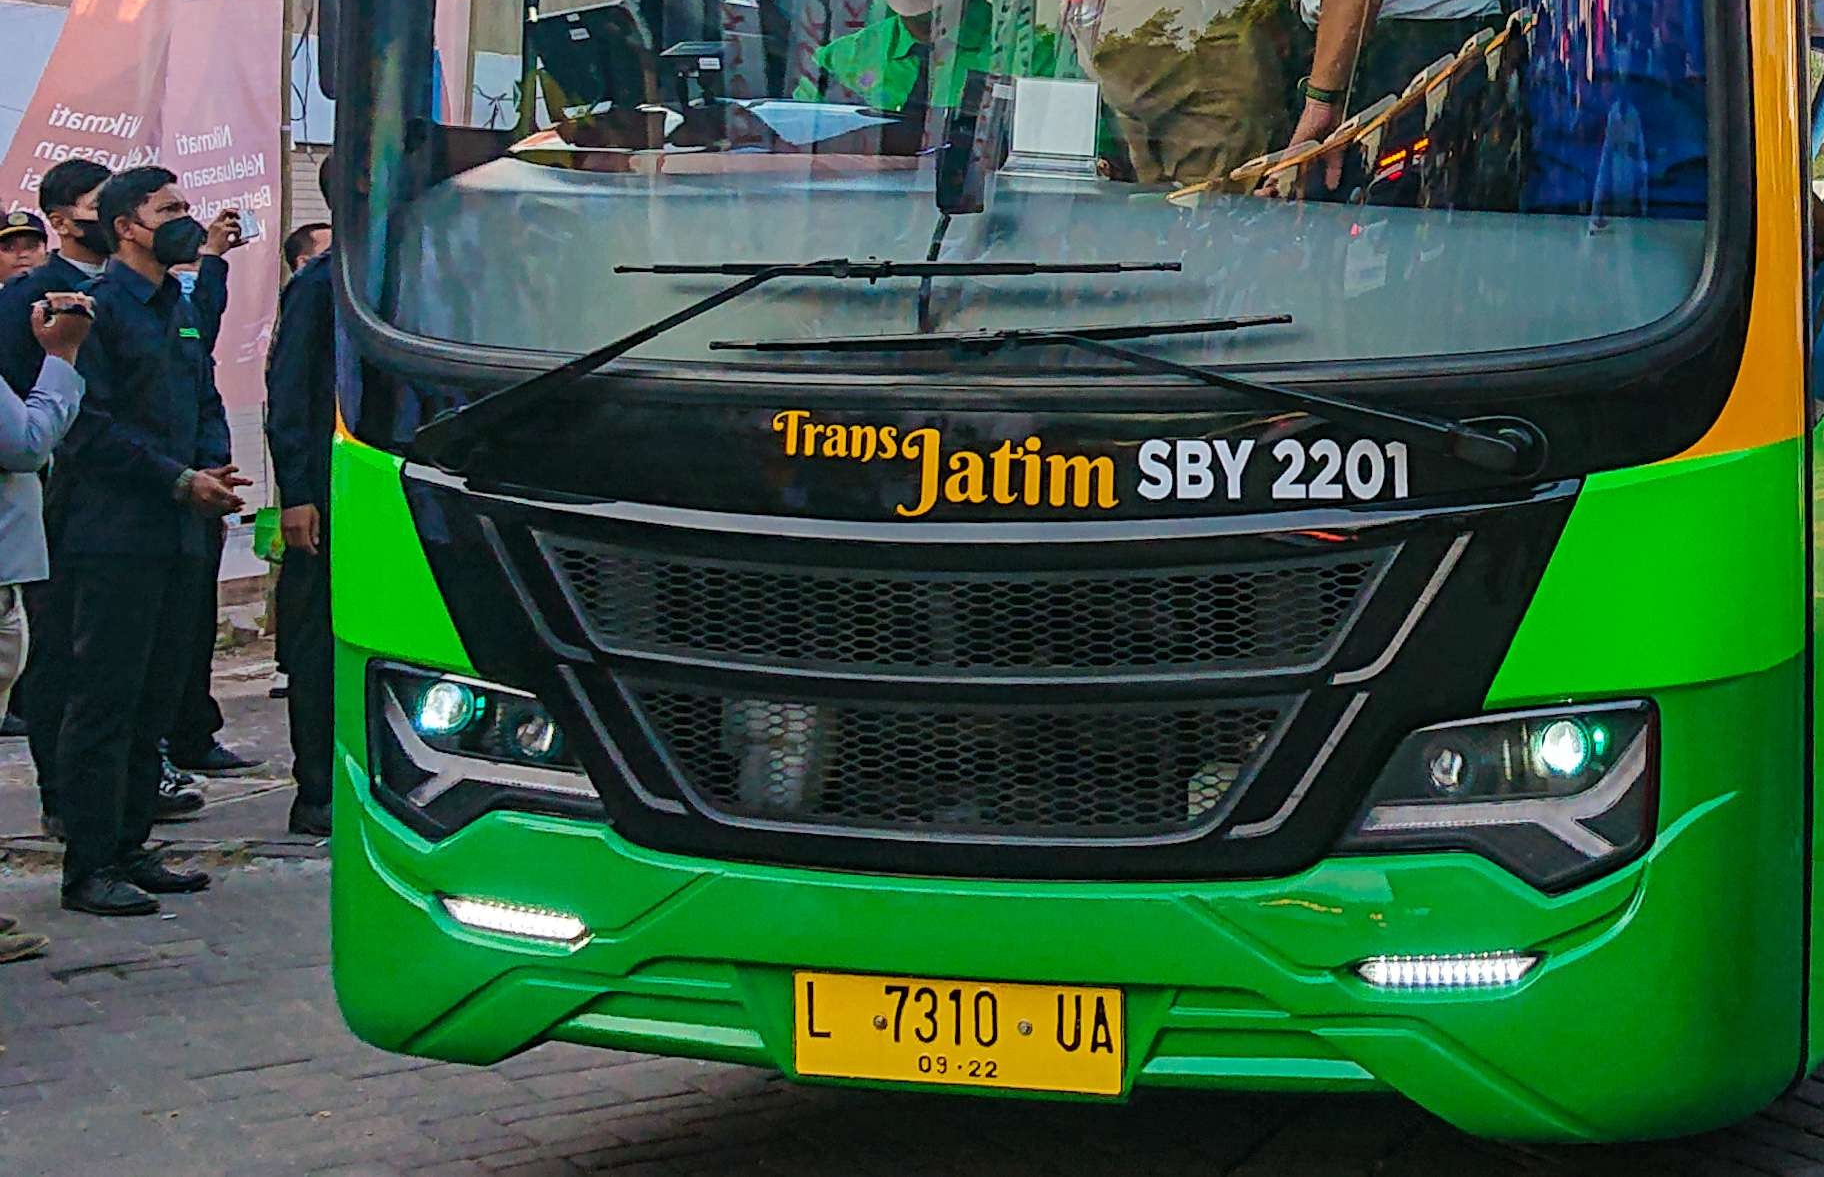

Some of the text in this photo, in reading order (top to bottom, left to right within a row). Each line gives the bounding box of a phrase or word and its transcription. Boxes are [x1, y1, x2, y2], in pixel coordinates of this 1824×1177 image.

[772, 409, 1409, 517] Trans Jatim SBY 2201
[807, 981, 1114, 1053] L 7310 UA
